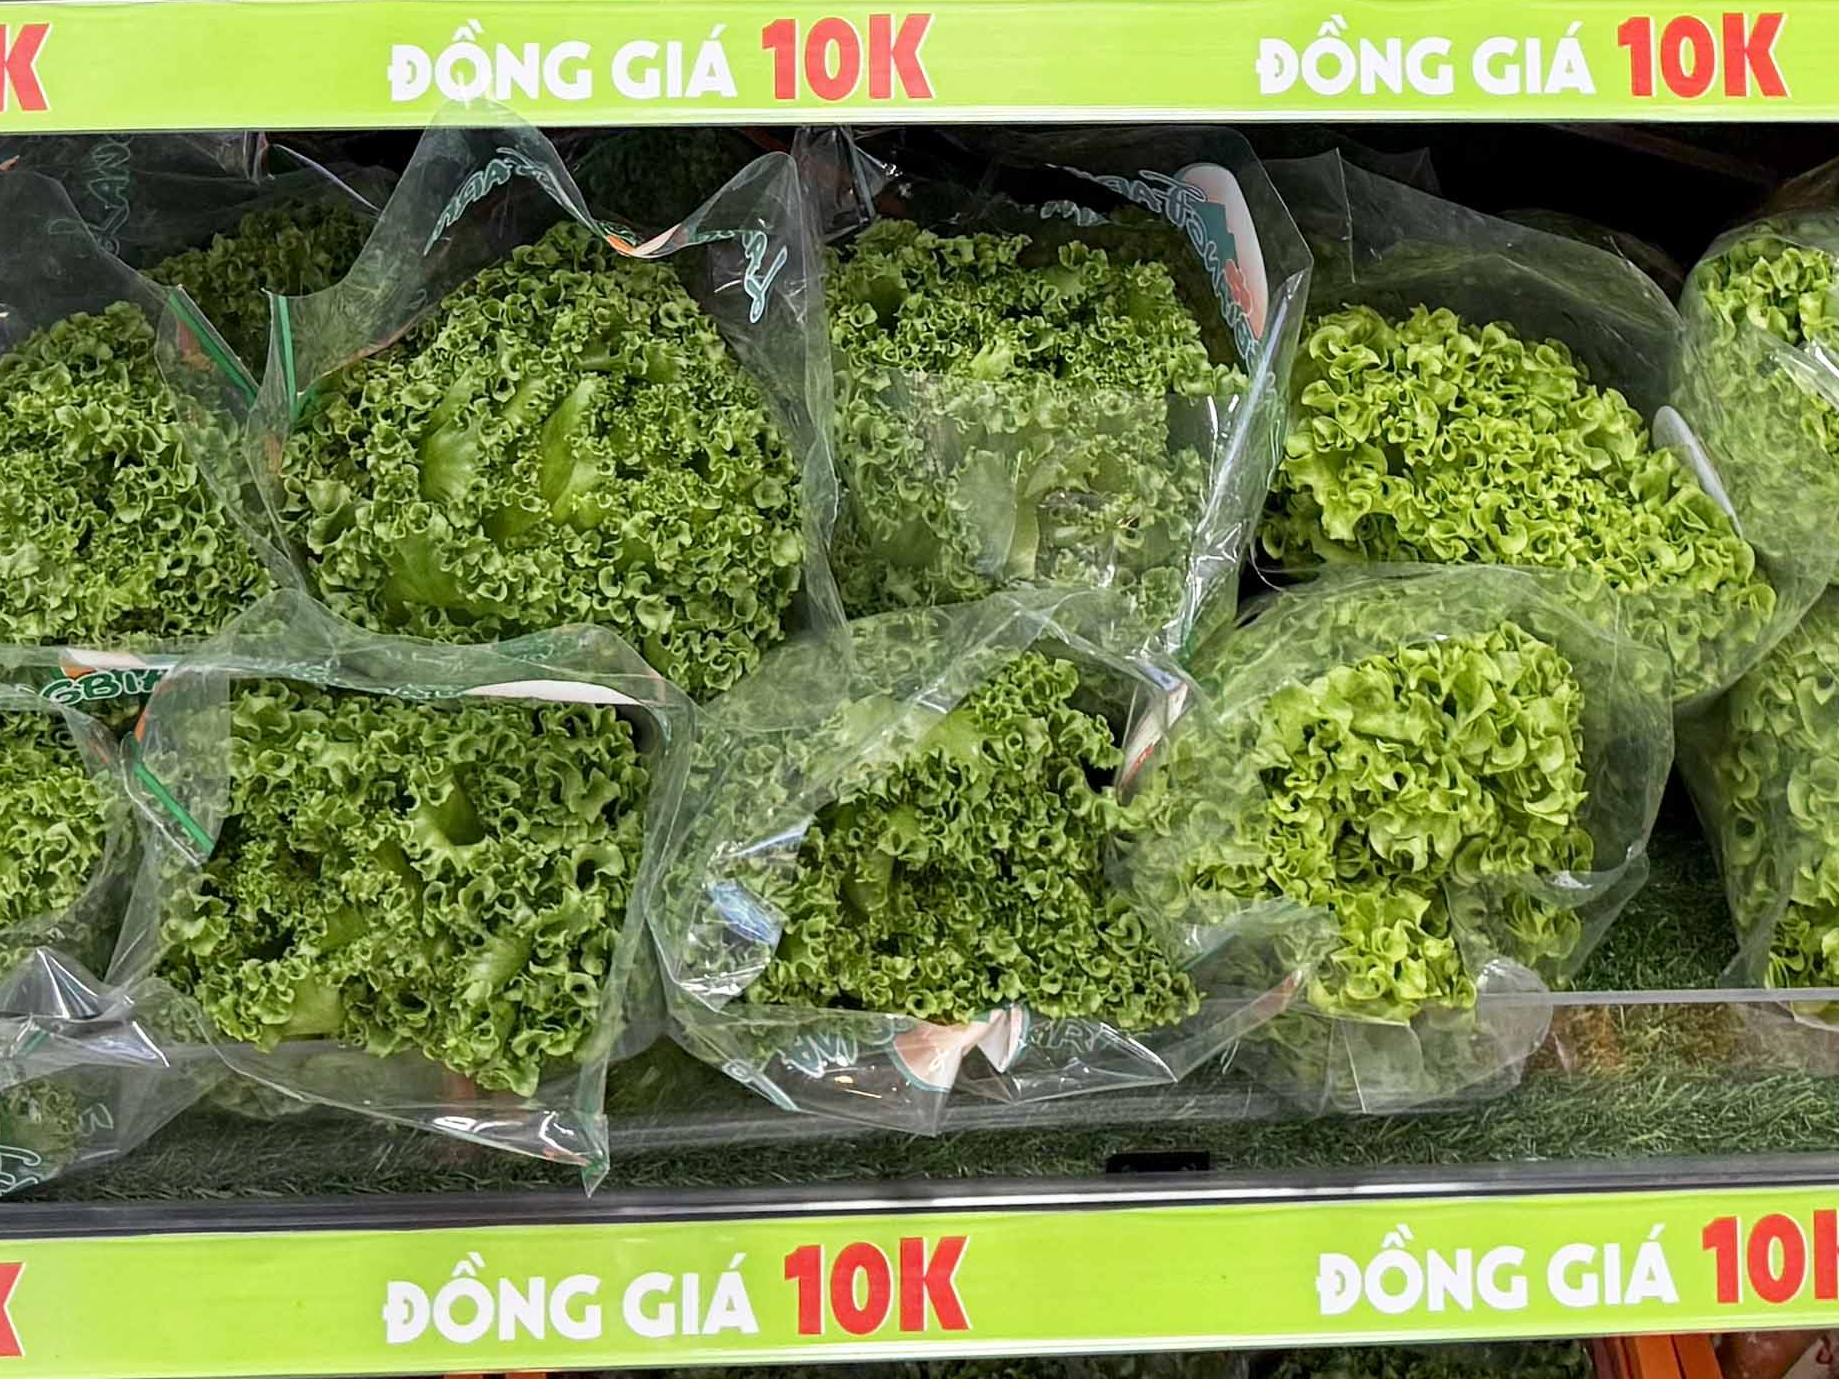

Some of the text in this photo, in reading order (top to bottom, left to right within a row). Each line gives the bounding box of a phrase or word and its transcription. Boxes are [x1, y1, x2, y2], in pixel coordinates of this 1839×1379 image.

[389, 14, 933, 103] ĐỒNG GIÁ 10K
[1256, 12, 1788, 99] ĐỒNG GIÁ 10K
[382, 1236, 969, 1344] ĐỒNG GIÁ 10K
[1316, 1227, 1527, 1314] ĐỒNG
[1547, 1223, 1678, 1308] GIÁ
